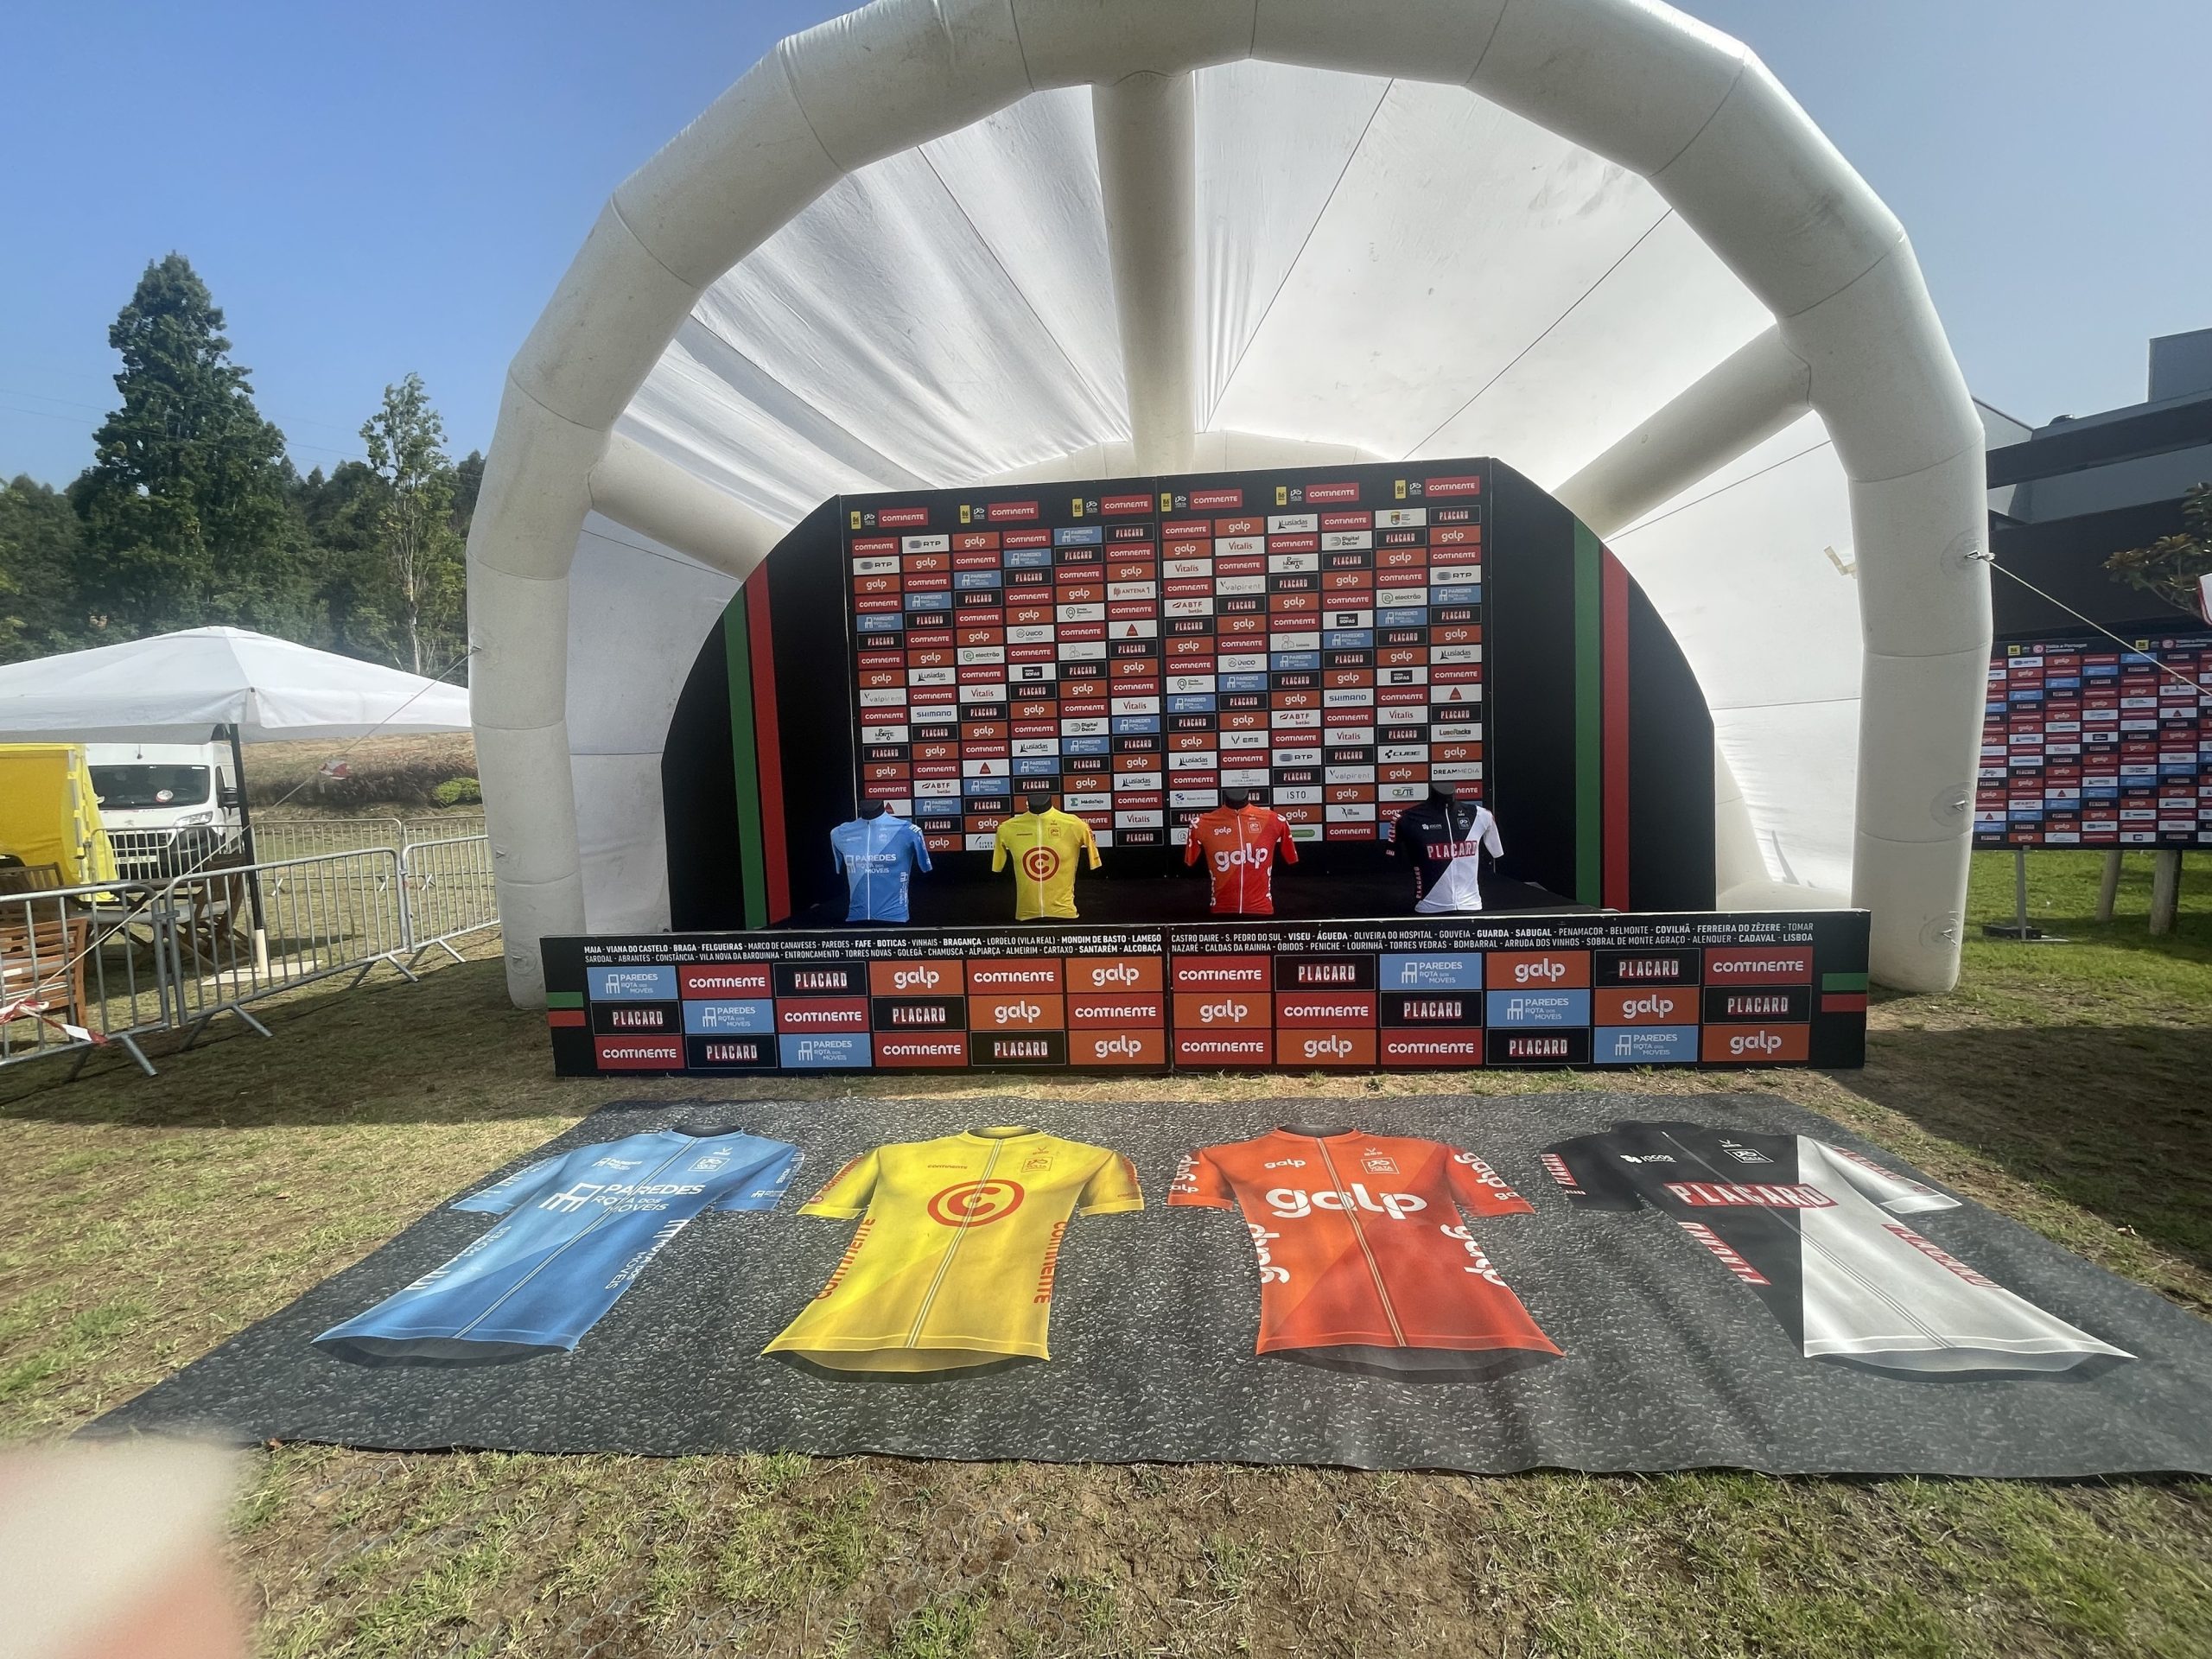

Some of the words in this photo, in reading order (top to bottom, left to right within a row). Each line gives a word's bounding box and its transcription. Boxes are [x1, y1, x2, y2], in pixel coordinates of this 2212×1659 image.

[1440, 512, 1468, 520] PLACARD
[965, 537, 985, 547] galp
[1127, 815, 1150, 823] Vitalis
[1214, 843, 1268, 871] galp
[1427, 842, 1478, 857] PLACARD
[1317, 931, 1348, 940] ÁGUEDA
[1400, 931, 1433, 939] HOSPITAL
[1478, 929, 1509, 938] GUARDA
[1611, 926, 1649, 935] BELMONTE
[1656, 923, 1690, 934] COVILHÃ
[1697, 925, 1736, 933] FERREIRA
[1751, 922, 1781, 931] ZÊZERE
[702, 942, 742, 950] FELGUEIRAS
[944, 938, 982, 947] BRAGANÇA
[1172, 943, 1198, 952] NAZARÉ
[1278, 942, 1303, 950] ÓBIDOS
[1347, 940, 1382, 950] LOURINHÃ
[1419, 940, 1446, 949] VEDRAS
[1553, 938, 1580, 946] VINHOS
[1656, 936, 1685, 945] AGRAÇO
[1693, 935, 1732, 944] ALENQUER
[1739, 934, 1776, 943] CADAVAL
[1783, 933, 1813, 942] LISBOA
[656, 952, 695, 961] CONSTÂNCIA
[898, 947, 922, 957] GOLEGÃ
[969, 947, 1001, 957] ALPIARÇA
[1079, 944, 1117, 953] SANTARÉM
[1124, 944, 1162, 953] ALCOBAÇA
[1092, 963, 1139, 986] galp
[1298, 964, 1356, 982] PLACARD
[1514, 958, 1566, 982] galp
[1713, 961, 1803, 972] CONTINENTE
[689, 977, 766, 988] CONTINENTE
[795, 972, 848, 988] PLACARD
[894, 966, 939, 988] galp
[974, 971, 1054, 982] CONTINENTE
[995, 1001, 1040, 1023] galp
[1199, 1000, 1248, 1022] galp
[1283, 1006, 1369, 1017] CONTINENTE
[1728, 996, 1789, 1014] PLACARD
[613, 1010, 664, 1027] PLACARD
[785, 1011, 862, 1022] CONTINENTE
[893, 1007, 946, 1023] PLACARD
[602, 1048, 677, 1058] CONTINENTE
[883, 1045, 961, 1055] CONTINENTE
[1304, 1035, 1352, 1058] galp
[1509, 1039, 1567, 1057] PLACARD
[1265, 1159, 1306, 1169] galp
[603, 1185, 705, 1195] PAREDES
[1170, 1184, 1199, 1192] alp
[1669, 1184, 1831, 1207] PLACARD
[591, 1196, 635, 1205] ROA
[1265, 1183, 1427, 1219] galp
